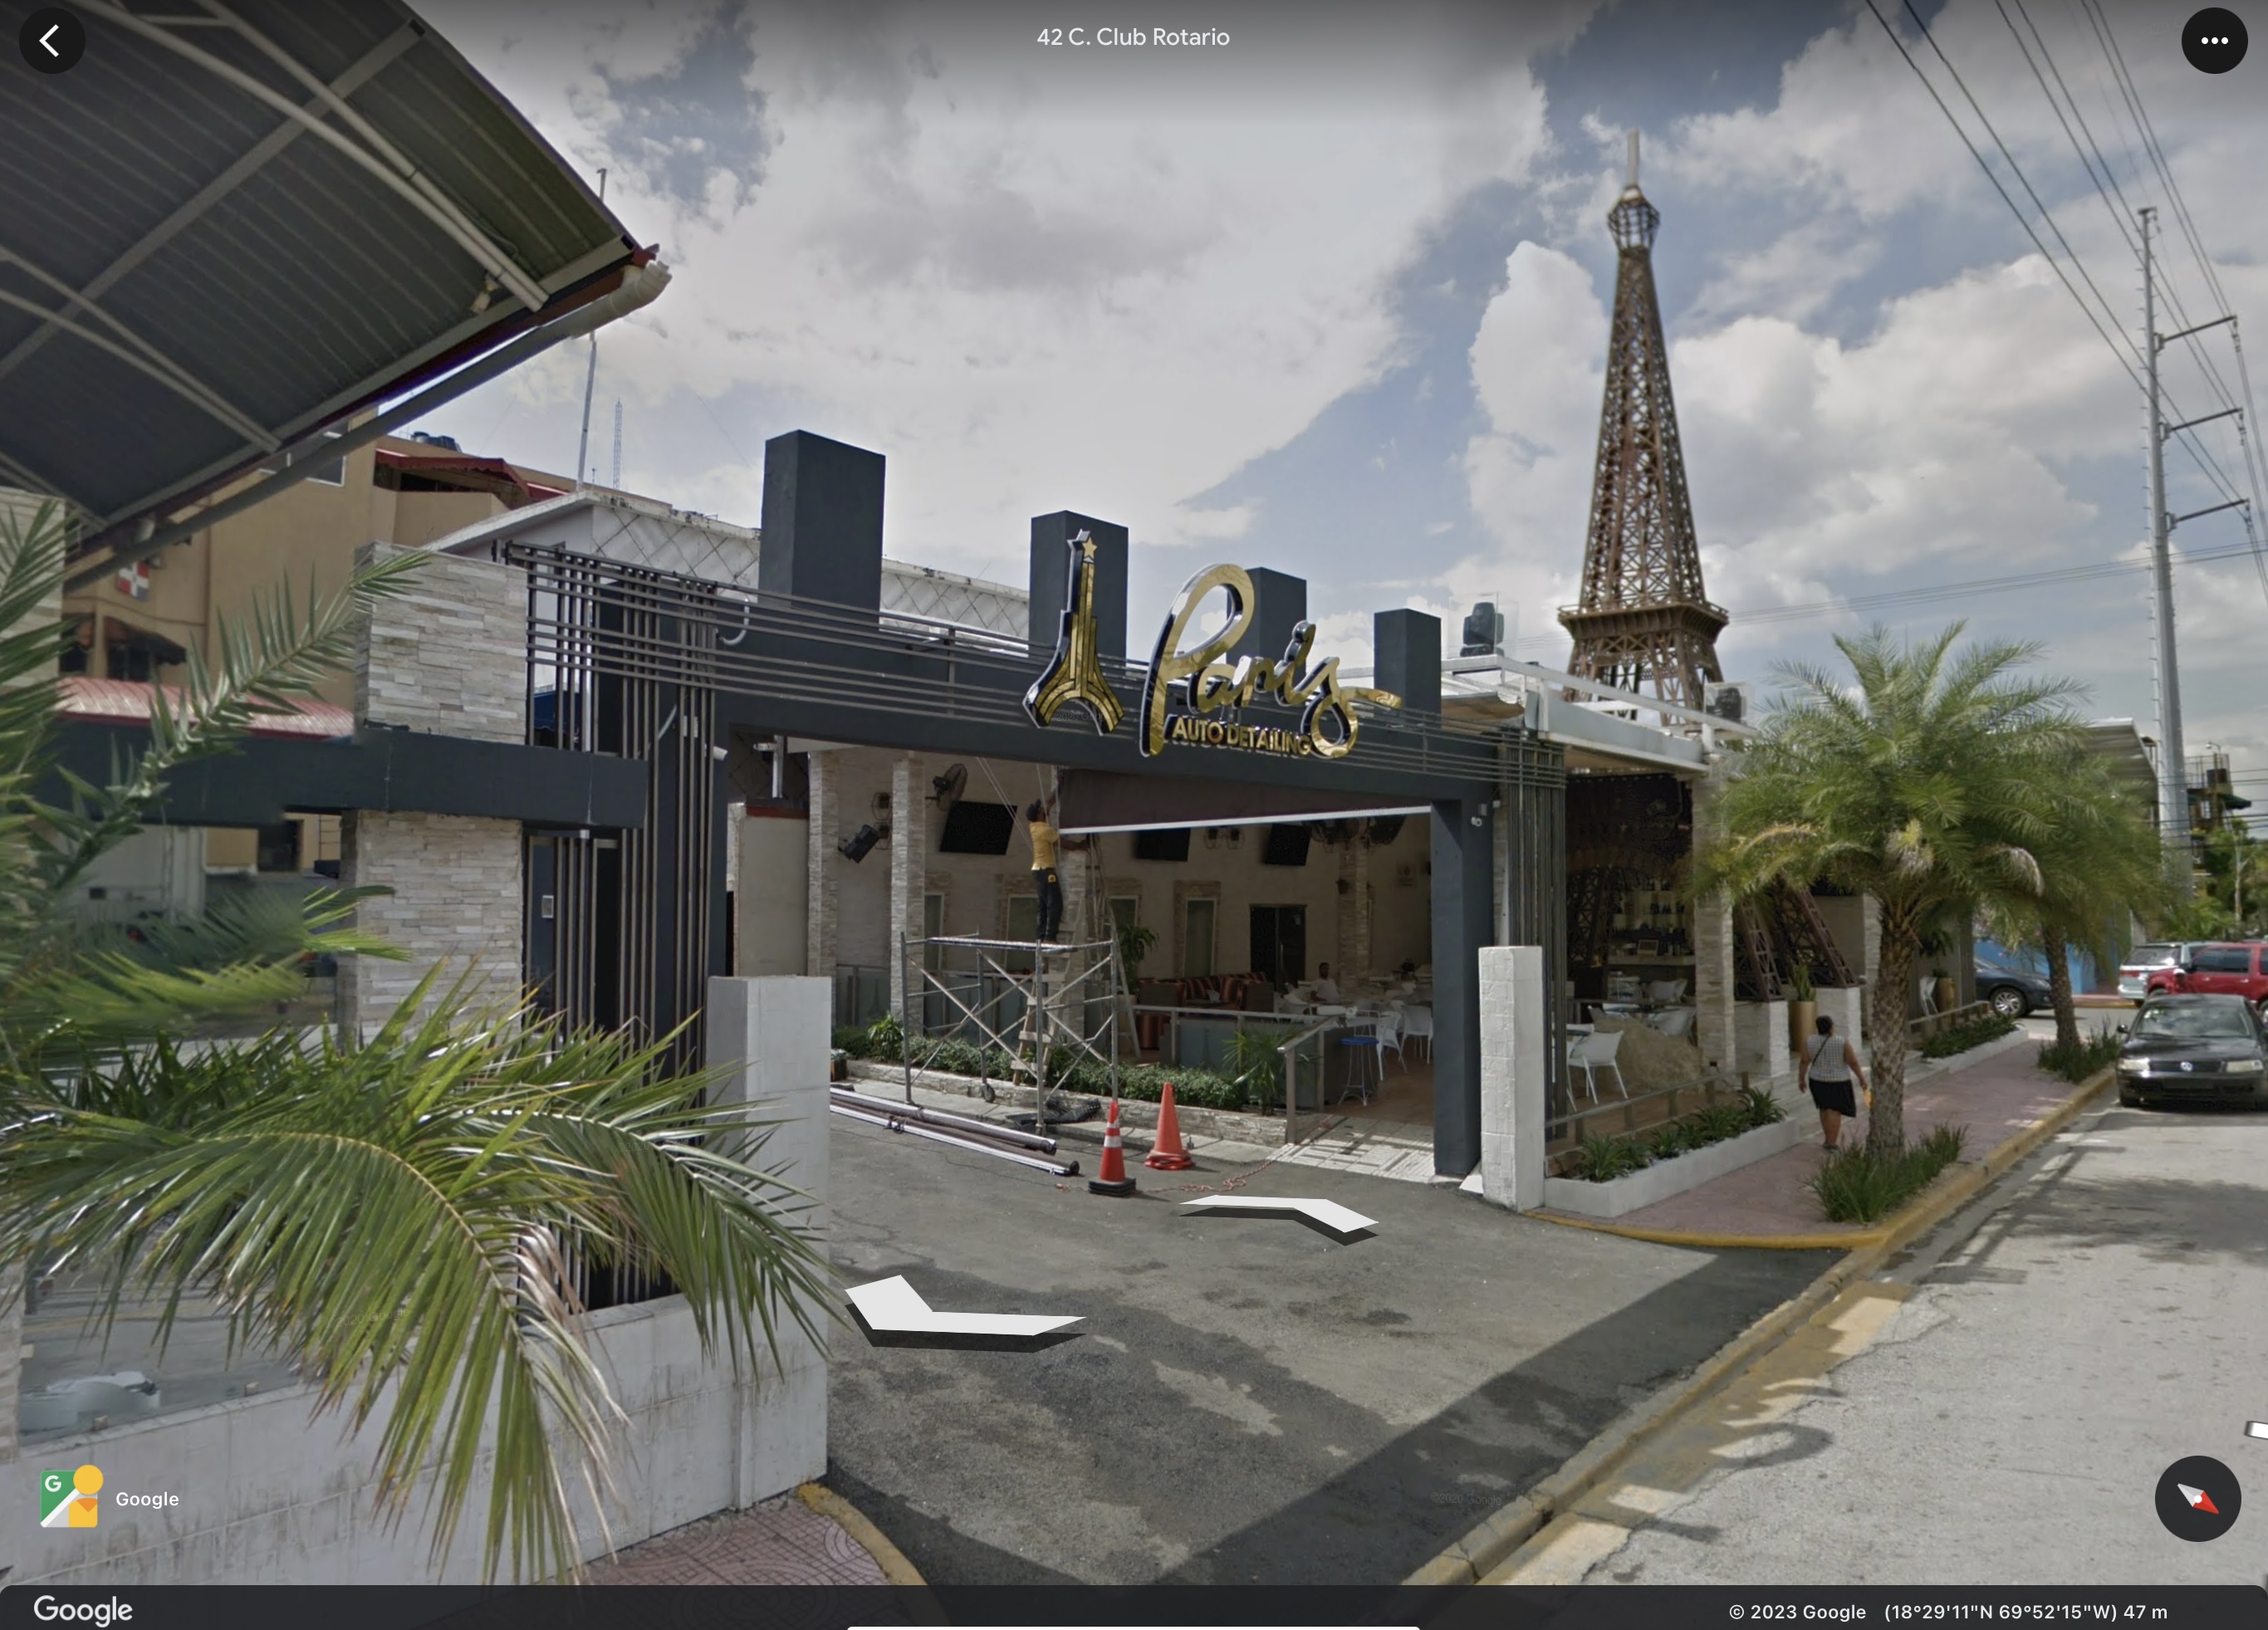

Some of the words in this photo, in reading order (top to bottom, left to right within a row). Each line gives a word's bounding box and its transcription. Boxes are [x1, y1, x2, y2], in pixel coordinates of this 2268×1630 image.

[1140, 563, 1402, 758] Paris
[1170, 716, 1224, 745] AUTO
[1226, 722, 1312, 756] DETAILING
